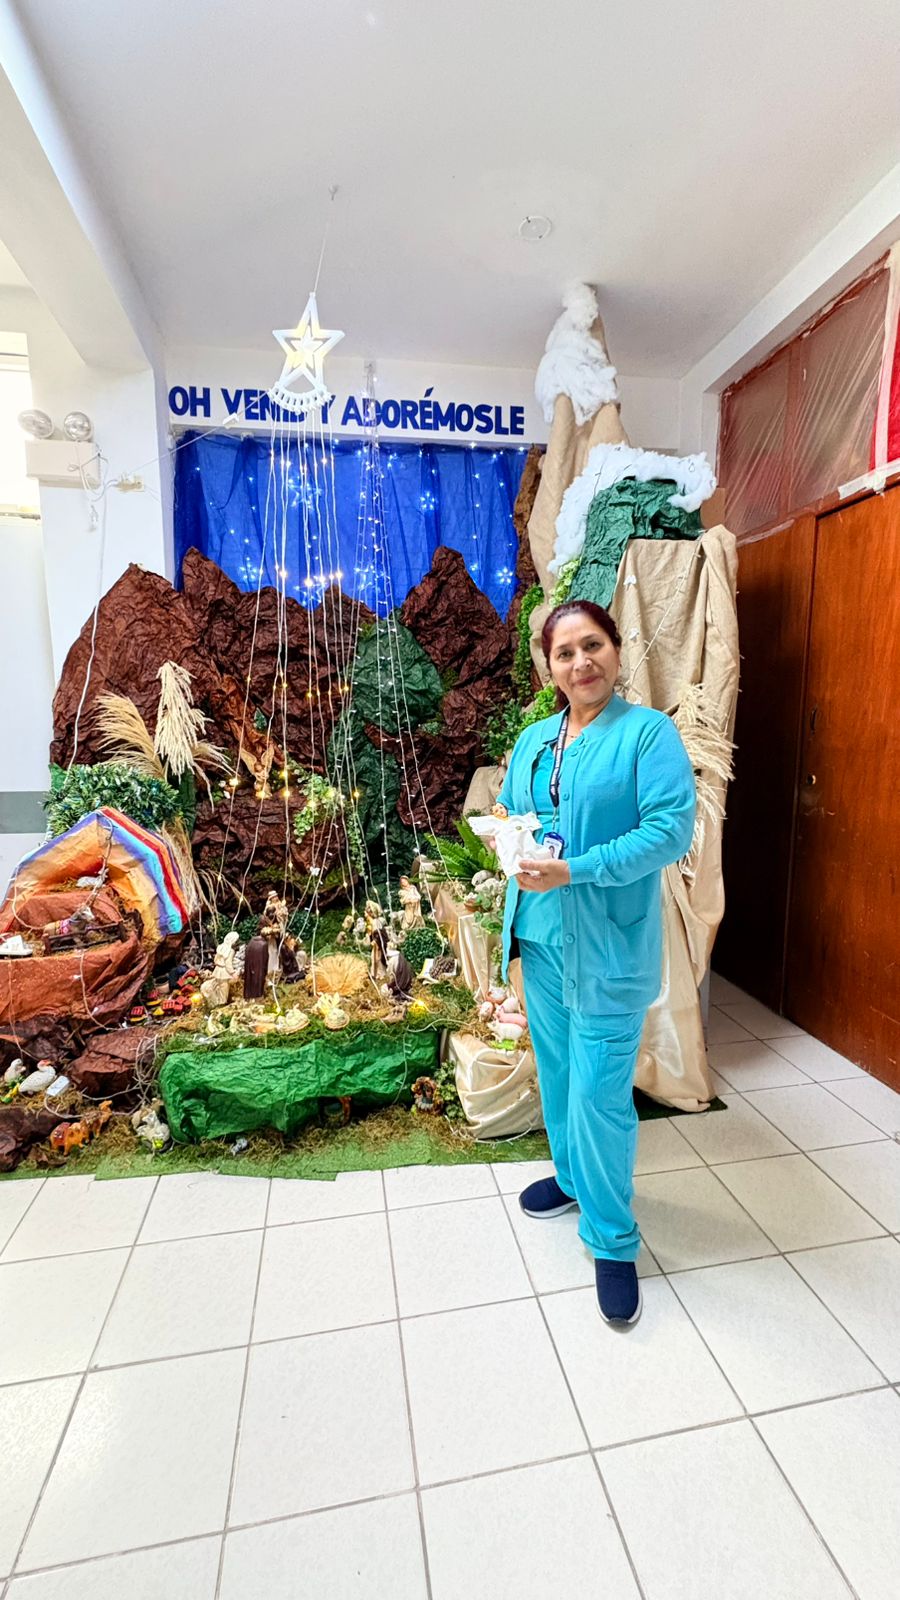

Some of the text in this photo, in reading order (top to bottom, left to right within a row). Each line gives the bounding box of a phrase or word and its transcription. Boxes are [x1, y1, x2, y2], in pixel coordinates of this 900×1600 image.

[168, 386, 211, 418] OH
[314, 394, 336, 425] Y
[341, 387, 525, 436] ADORÉMOSLE
